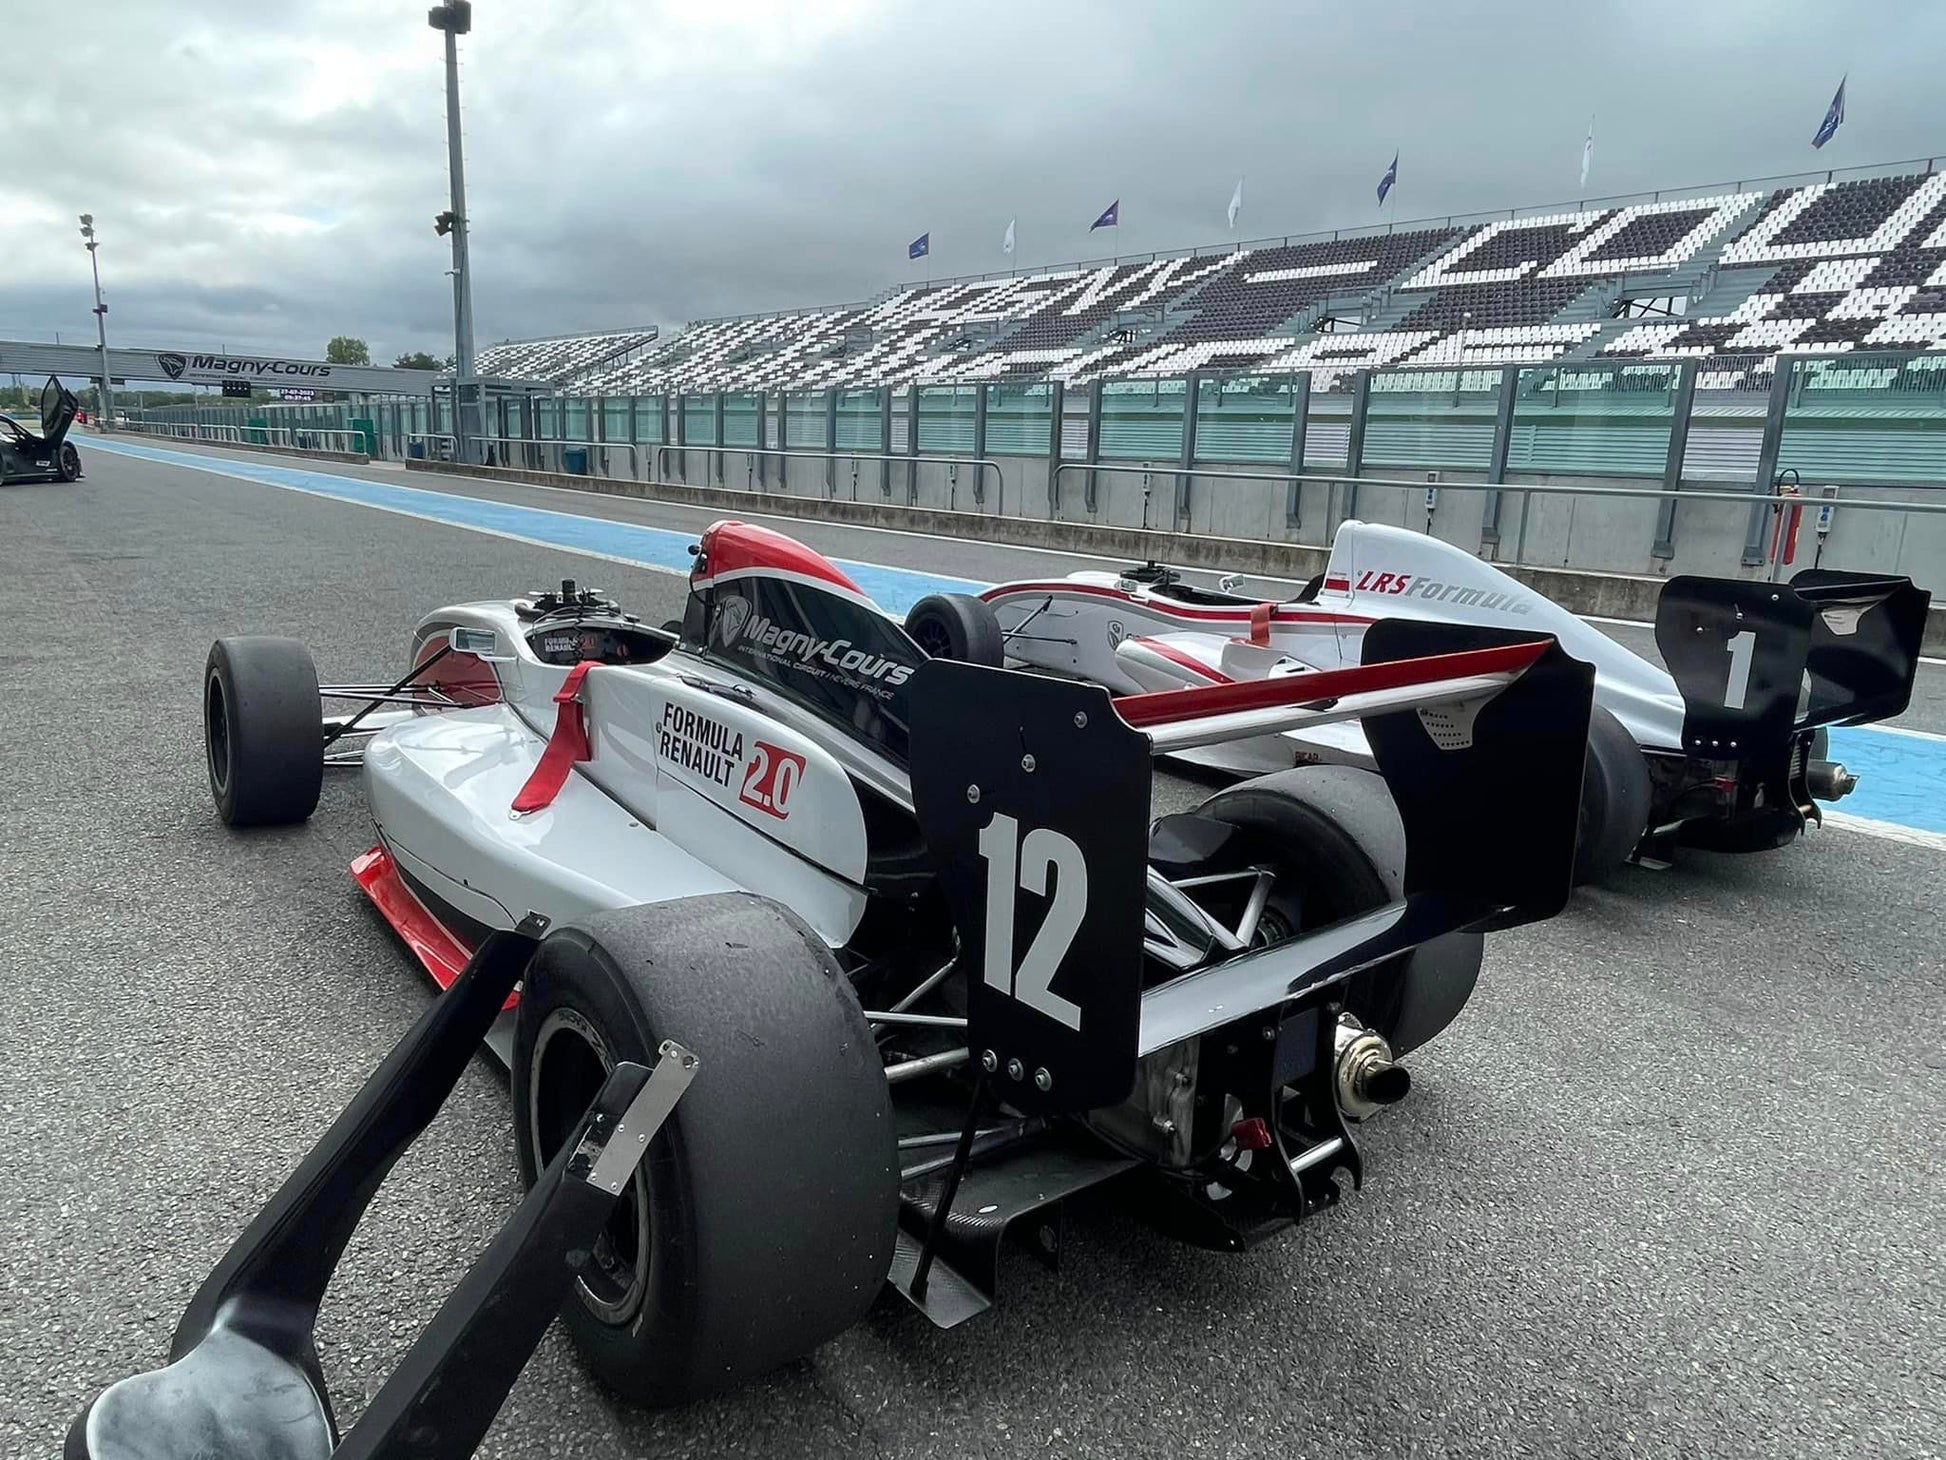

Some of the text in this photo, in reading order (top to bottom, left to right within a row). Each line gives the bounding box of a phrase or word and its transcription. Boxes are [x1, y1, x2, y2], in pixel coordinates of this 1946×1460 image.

[1399, 170, 1946, 289] COU
[192, 356, 331, 377] Magny-Cours
[743, 615, 916, 686] Magny-Cours
[1724, 630, 1757, 710] 1
[659, 731, 735, 788] RENAULT
[663, 700, 743, 762] FORMULA
[742, 746, 799, 813] 2.0
[978, 811, 1088, 1032] 12
